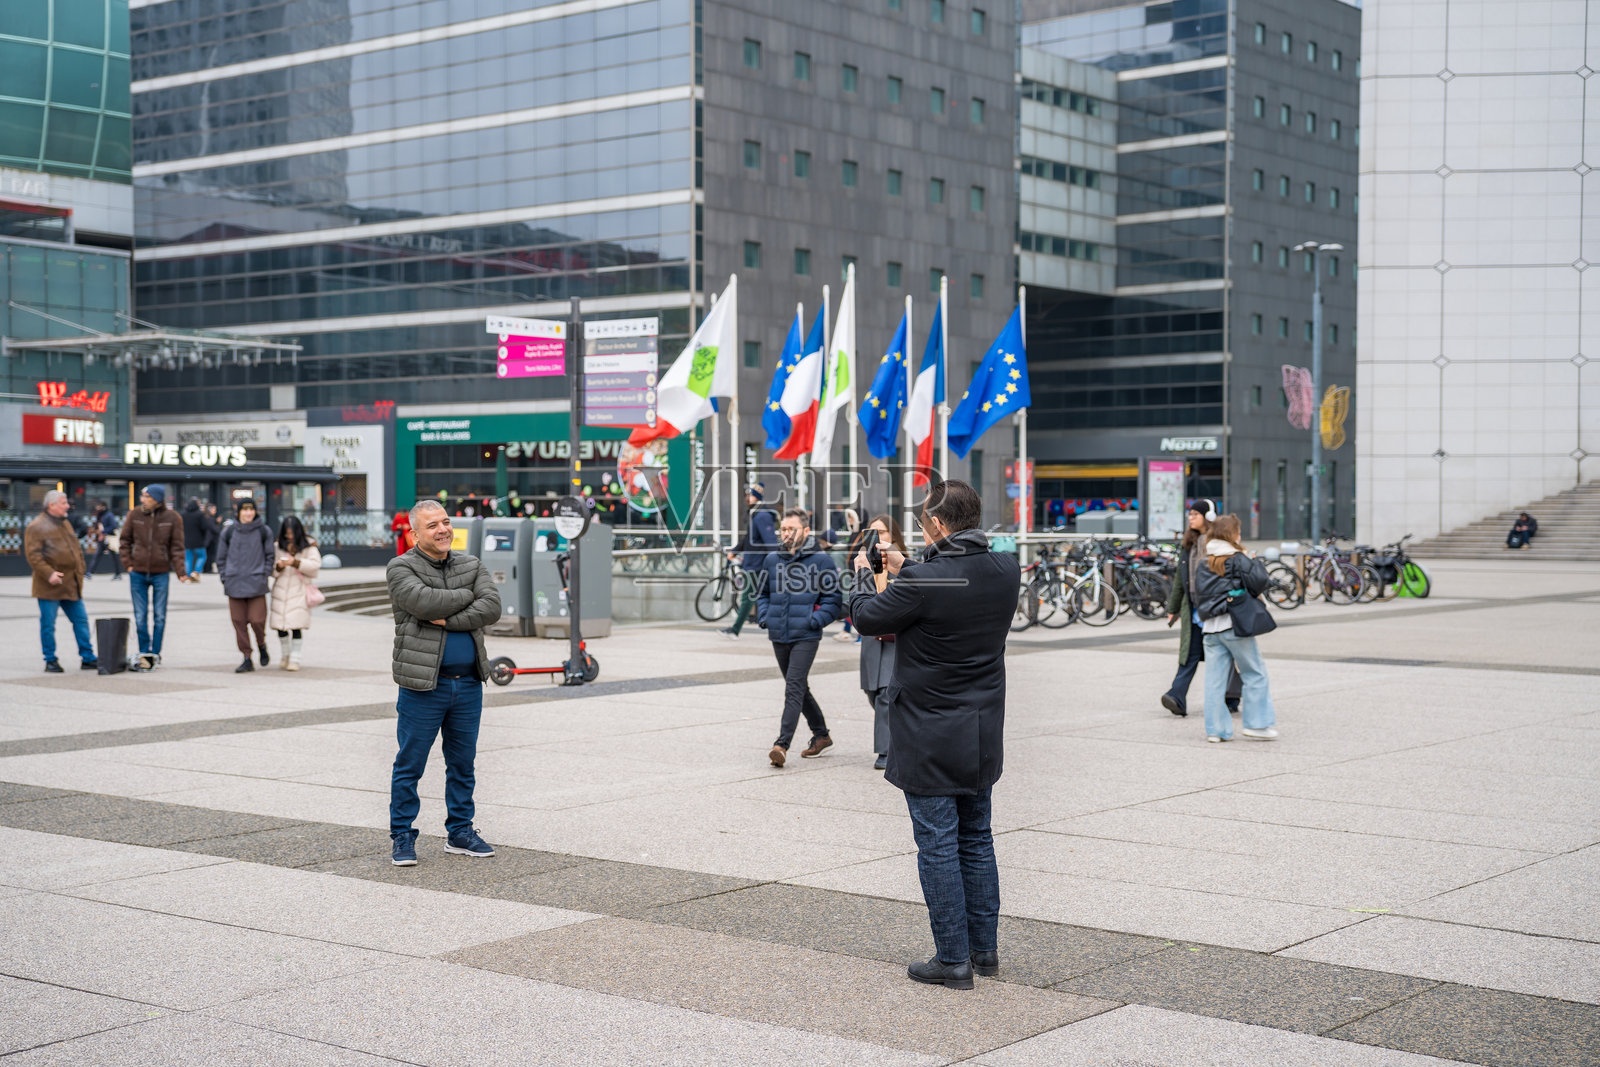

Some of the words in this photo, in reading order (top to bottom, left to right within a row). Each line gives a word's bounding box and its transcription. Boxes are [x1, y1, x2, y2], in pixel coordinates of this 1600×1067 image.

[53, 418, 93, 443] FIVE
[124, 443, 180, 465] FIVE
[182, 445, 247, 467] GUYS
[1160, 436, 1218, 452] Noura
